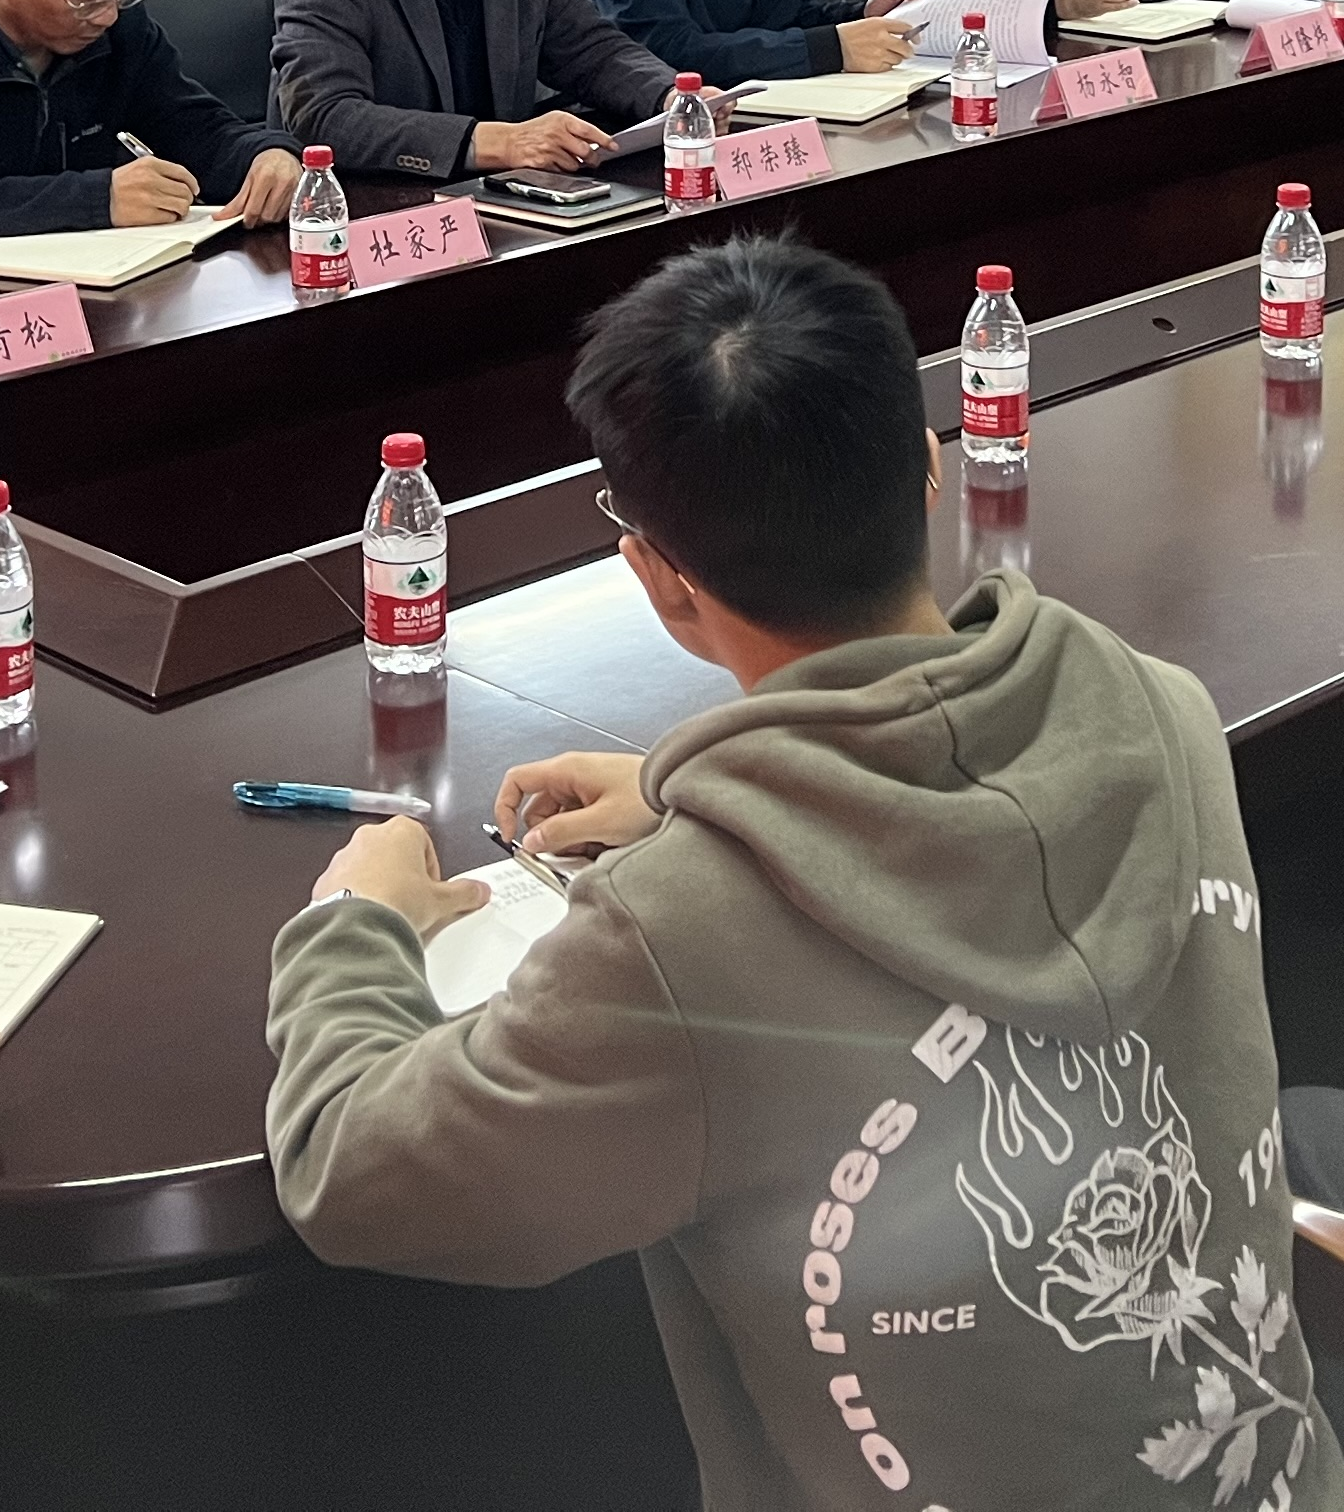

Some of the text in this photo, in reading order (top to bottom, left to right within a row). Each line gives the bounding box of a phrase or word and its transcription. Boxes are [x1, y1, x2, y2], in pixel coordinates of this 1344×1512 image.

[1076, 59, 1136, 99] 杨永智
[731, 133, 809, 180] 郑荣臻
[369, 214, 459, 266] 杜家严
[802, 1097, 918, 1354] roses
[872, 1303, 977, 1335] SINCE
